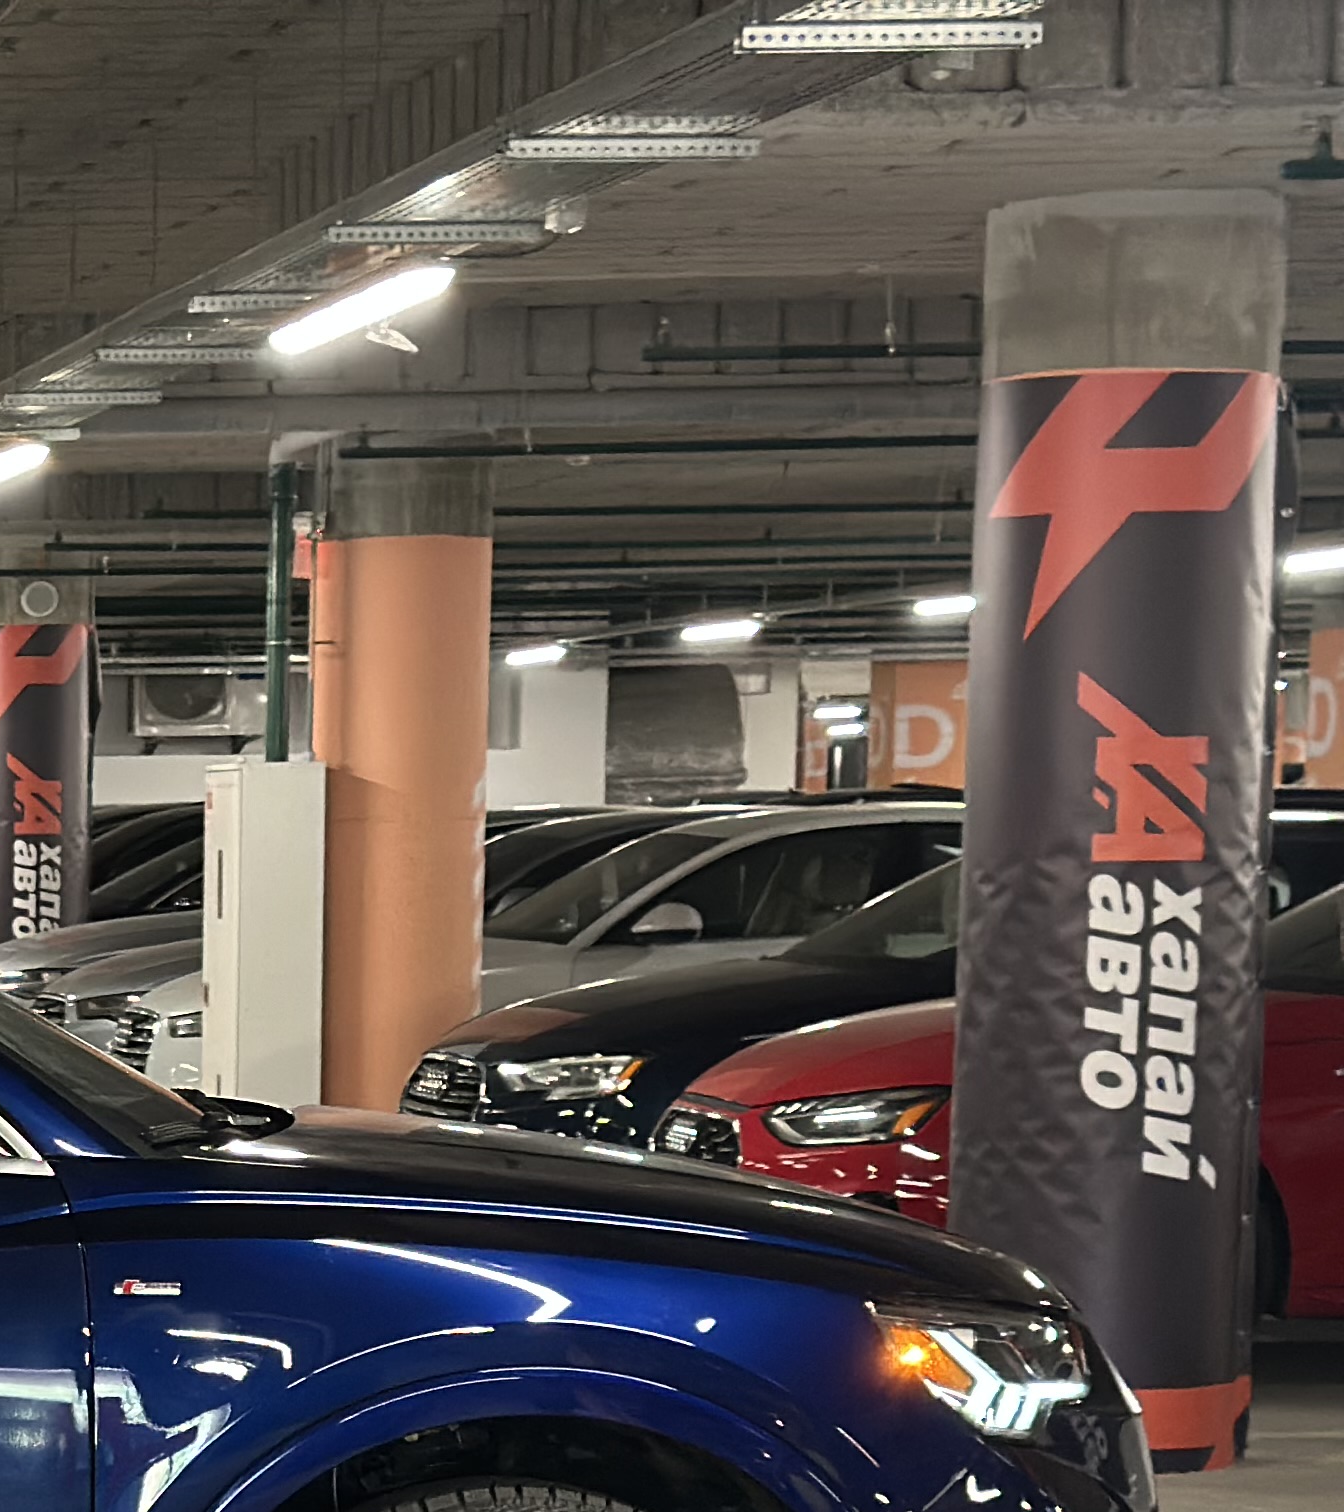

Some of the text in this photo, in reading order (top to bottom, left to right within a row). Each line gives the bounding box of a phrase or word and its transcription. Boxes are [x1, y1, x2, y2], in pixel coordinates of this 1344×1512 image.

[893, 704, 955, 769] D
[12, 840, 37, 939] авто
[39, 842, 62, 936] хапа
[1080, 873, 1145, 1111] авто
[1141, 878, 1217, 1190] хапай
